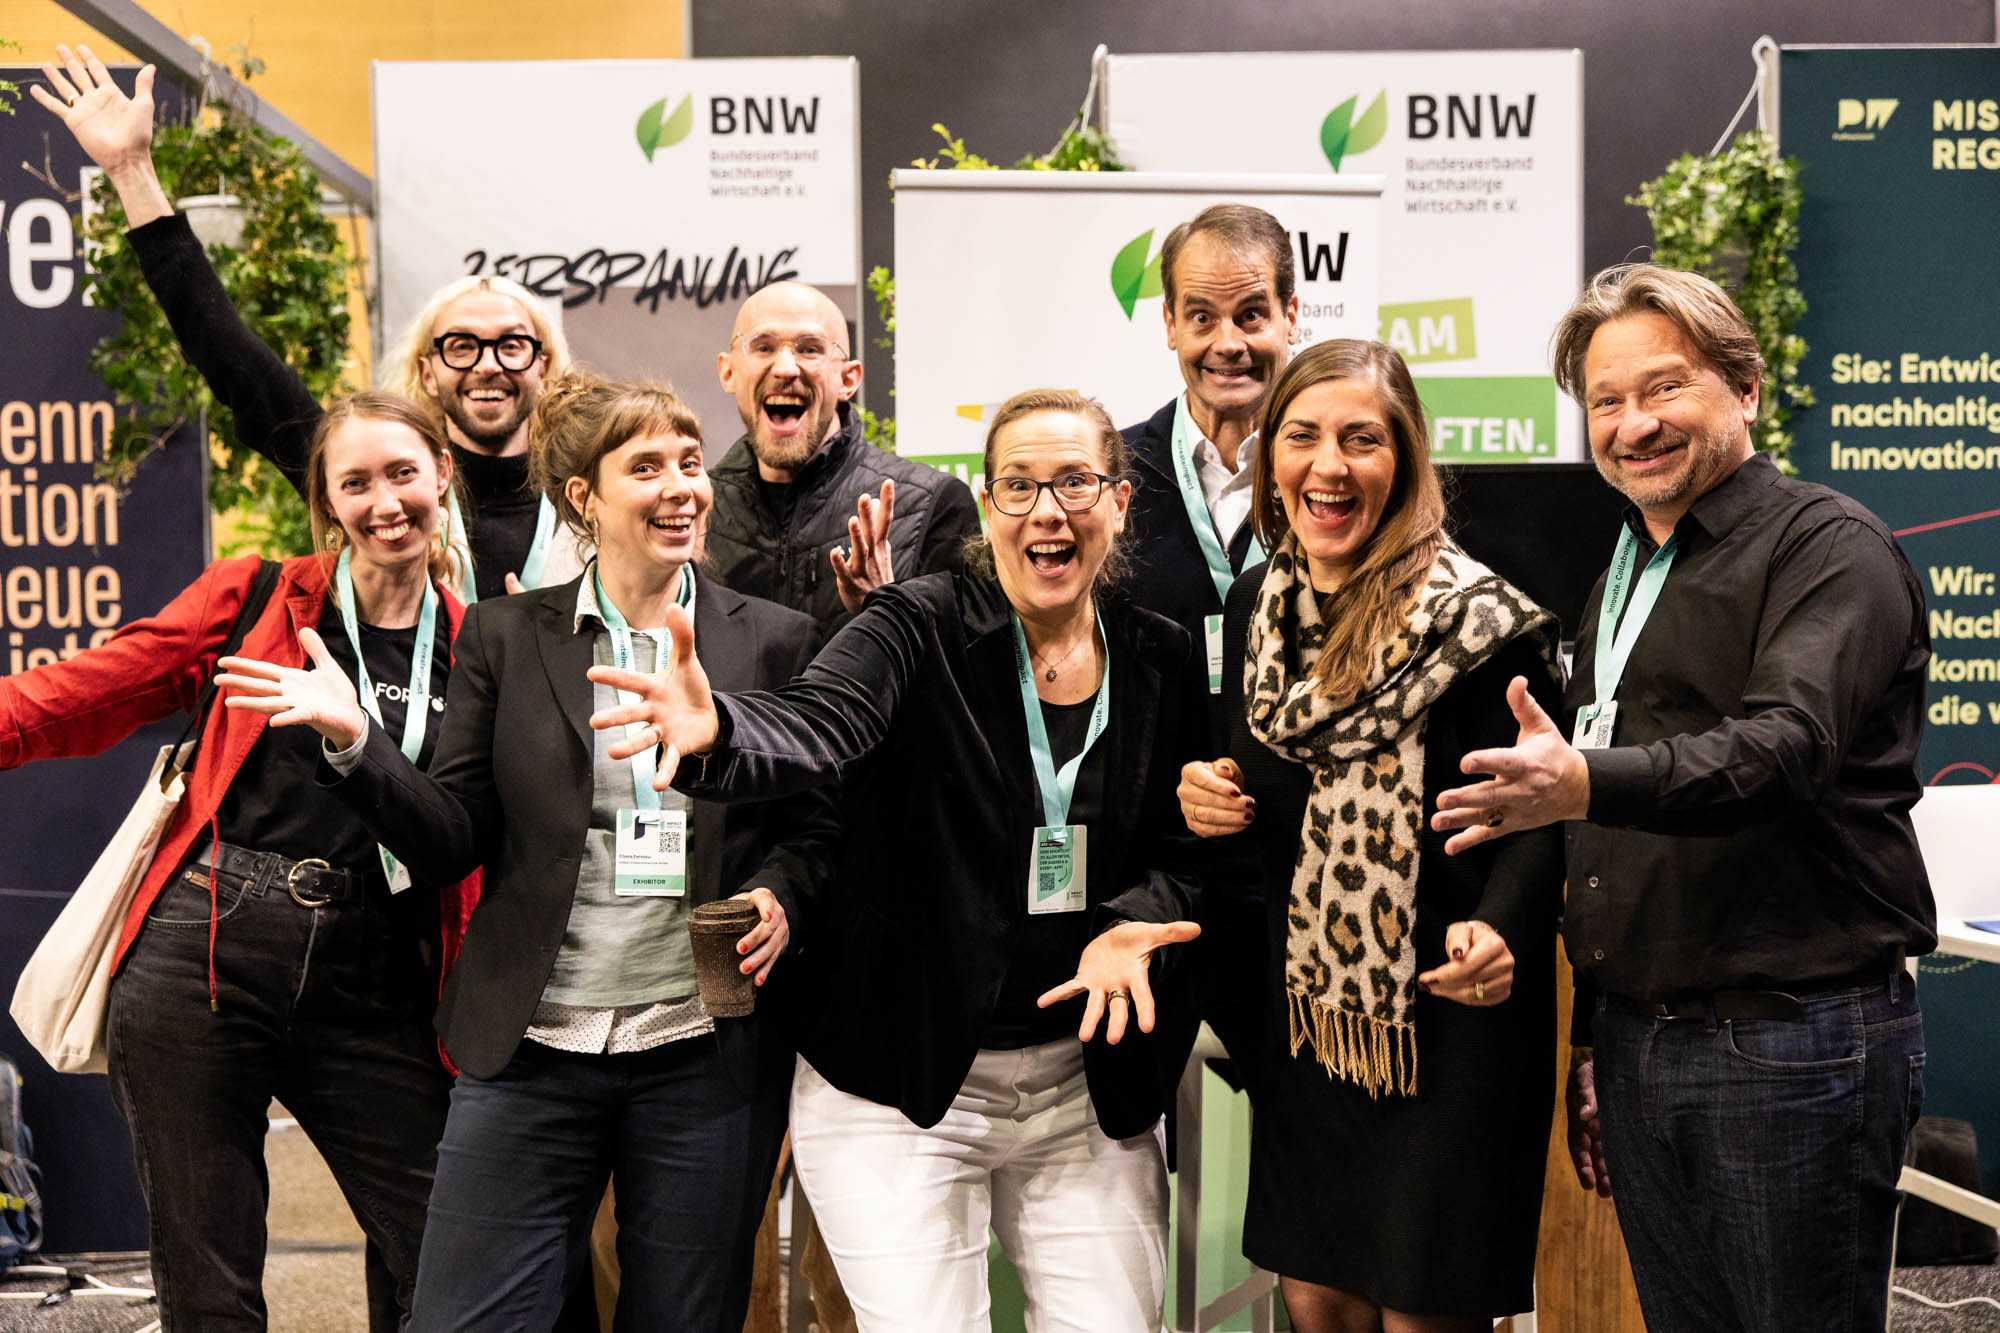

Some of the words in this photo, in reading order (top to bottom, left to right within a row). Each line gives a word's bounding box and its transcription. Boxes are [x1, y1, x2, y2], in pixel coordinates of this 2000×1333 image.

[711, 97, 819, 134] BNW
[1408, 94, 1536, 139] BNW
[1933, 99, 2000, 131] MIS
[711, 150, 818, 161] Bundesverband
[1406, 157, 1532, 170] Bundesverband
[1932, 137, 2000, 170] REG
[711, 167, 792, 181] Nachhaltige
[1406, 178, 1503, 194] Nachhaltige
[711, 184, 780, 196] Wirtschaft
[1406, 199, 1488, 212] Wirtschaft
[1298, 303, 1344, 318] band
[1377, 314, 1456, 358] AM
[1831, 352, 1892, 384] Sie:
[1831, 396, 2000, 433] nachhaltig
[1831, 439, 2000, 471] Innovation
[1929, 565, 1995, 596] Wir:
[0, 565, 122, 630] eue
[1928, 652, 2000, 682] kom
[1928, 695, 1981, 726] die
